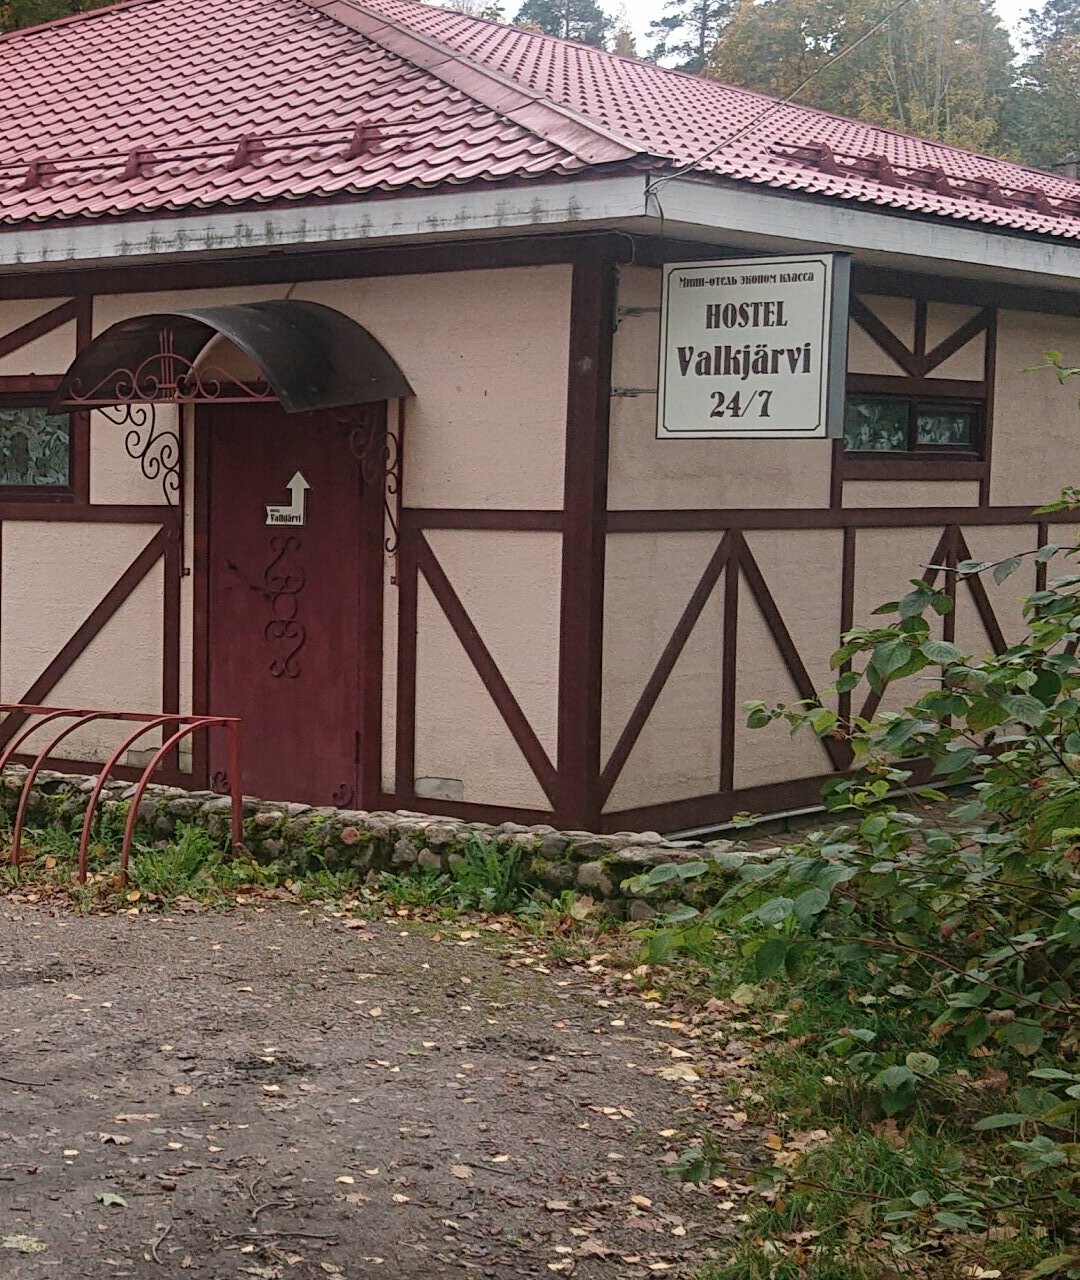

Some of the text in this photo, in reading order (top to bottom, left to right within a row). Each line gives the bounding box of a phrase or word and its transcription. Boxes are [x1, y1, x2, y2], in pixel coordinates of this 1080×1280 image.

[679, 272, 814, 288] Мини-отель эконом класса
[705, 300, 788, 329] HOSTEL
[676, 342, 812, 381] Valkjärvi
[710, 390, 773, 418] 24/7
